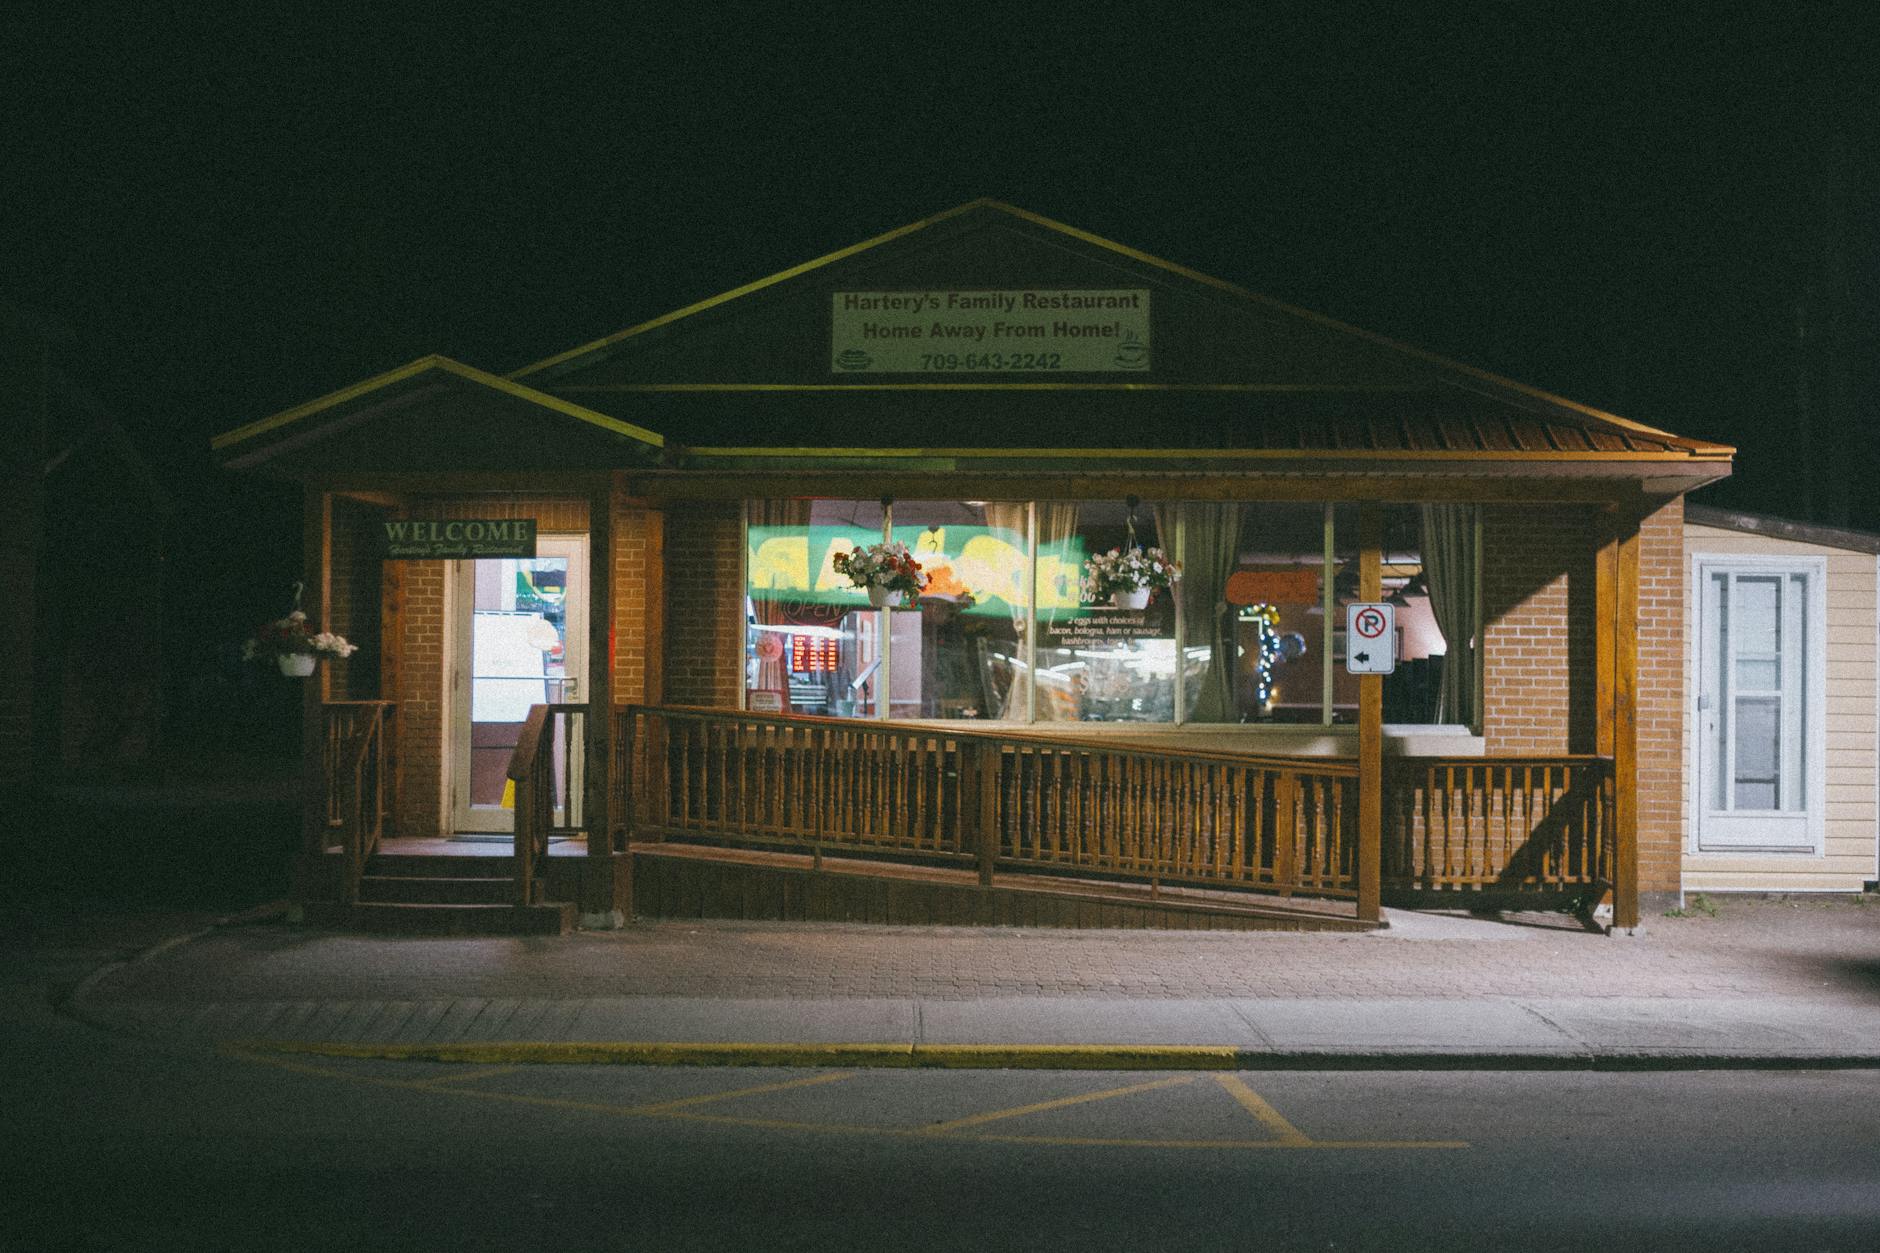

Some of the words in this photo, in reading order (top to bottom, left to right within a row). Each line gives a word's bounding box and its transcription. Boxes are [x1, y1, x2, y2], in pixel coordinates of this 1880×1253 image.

[844, 292, 940, 313] Hartery's
[947, 292, 1017, 313] Family
[1023, 291, 1140, 310] Restaurant
[862, 322, 922, 339] Home
[930, 321, 986, 341] Away
[993, 321, 1045, 338] From
[1053, 319, 1120, 338] Home!
[921, 352, 1061, 371] 709-643-2242
[384, 521, 528, 541] WELCOME
